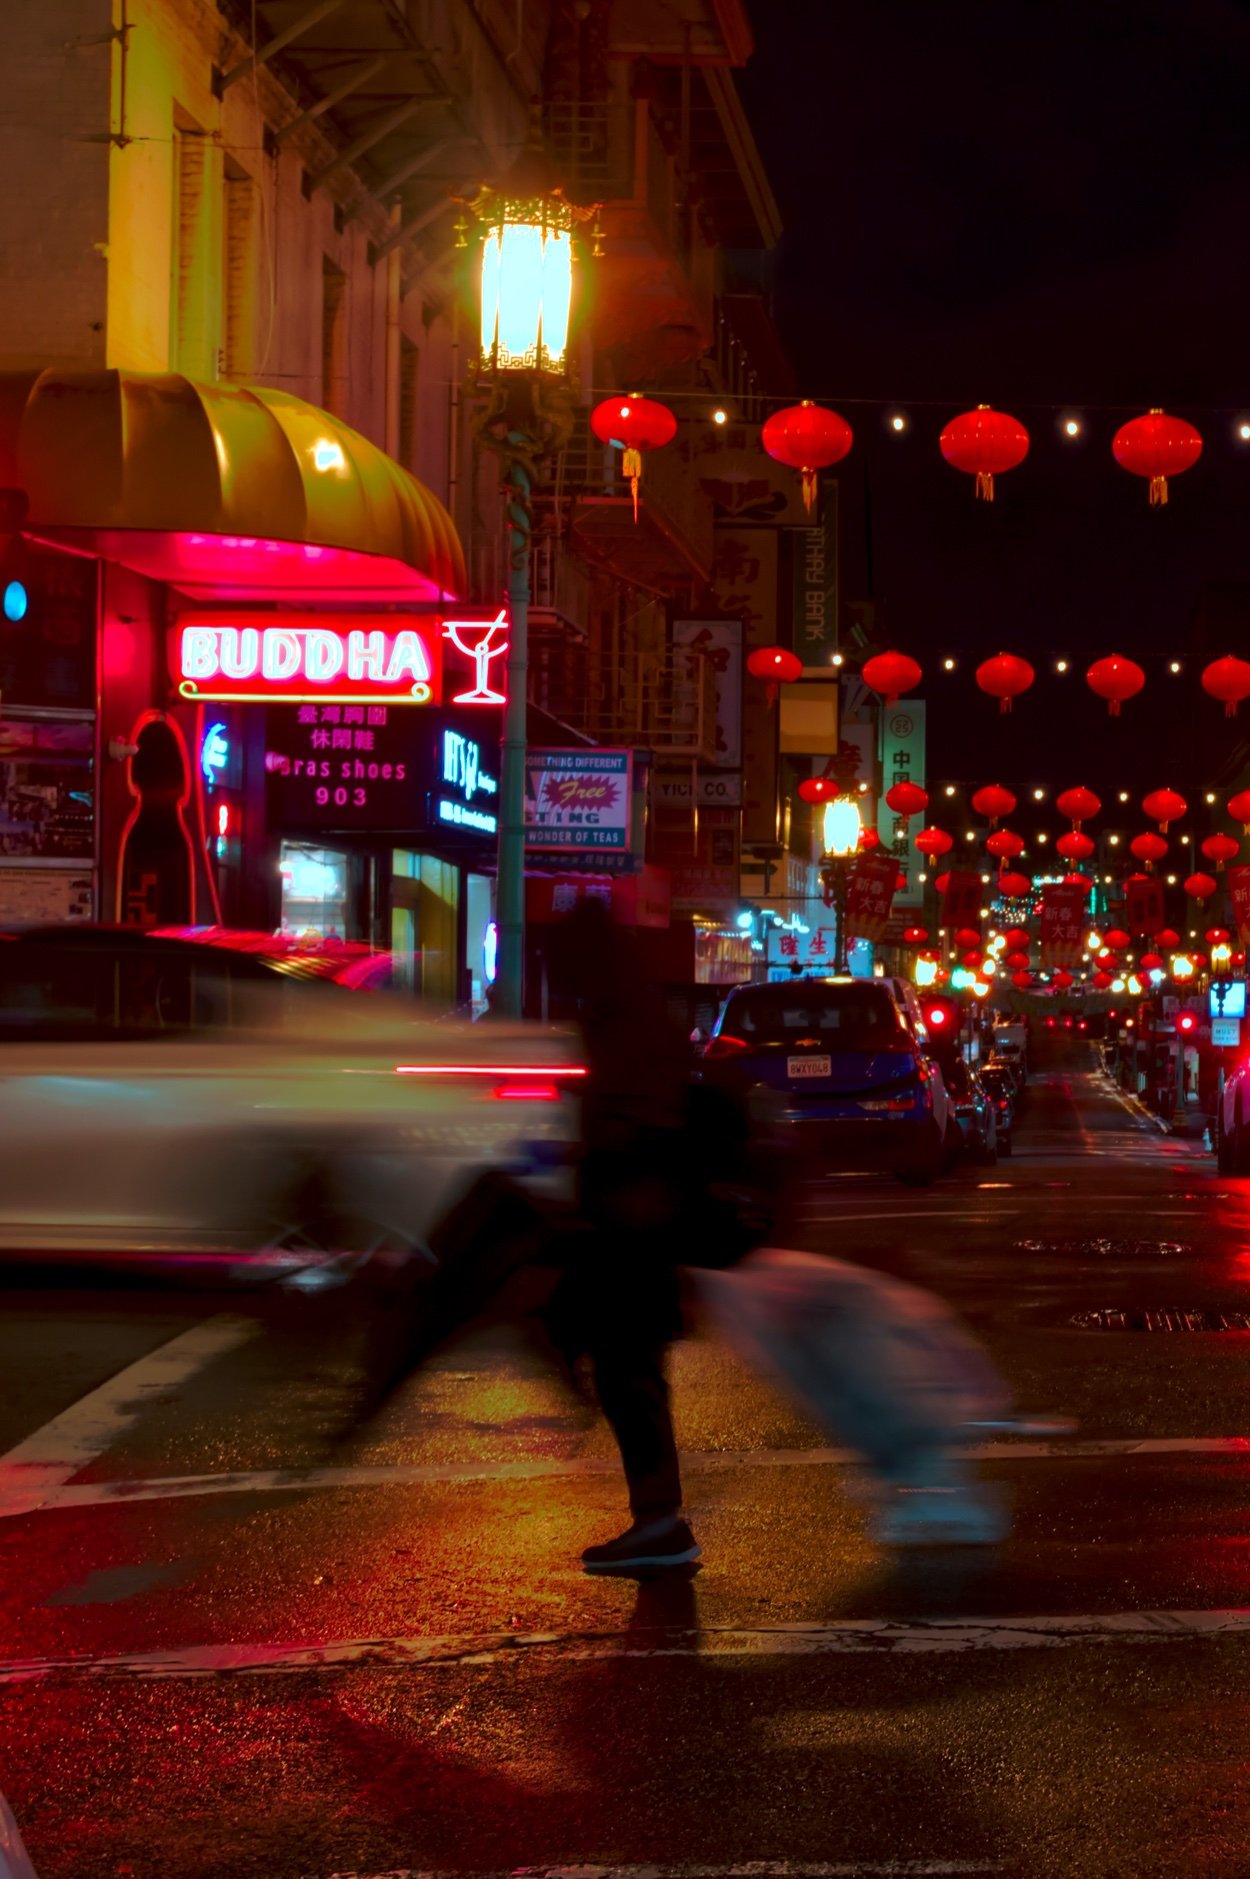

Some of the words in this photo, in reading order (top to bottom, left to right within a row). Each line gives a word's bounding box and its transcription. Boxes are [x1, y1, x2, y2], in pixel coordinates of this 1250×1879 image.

[804, 512, 826, 585] ATHAY
[805, 591, 826, 641] BANK
[181, 627, 430, 681] BUDDHA
[340, 758, 406, 780] shoes
[526, 756, 573, 769] OMETHING
[575, 756, 623, 769] DIFFERENT
[315, 786, 367, 806] 903
[557, 780, 607, 806] Free
[528, 829, 572, 842] WONDER
[575, 830, 589, 842] OF
[592, 830, 620, 843] TEAS
